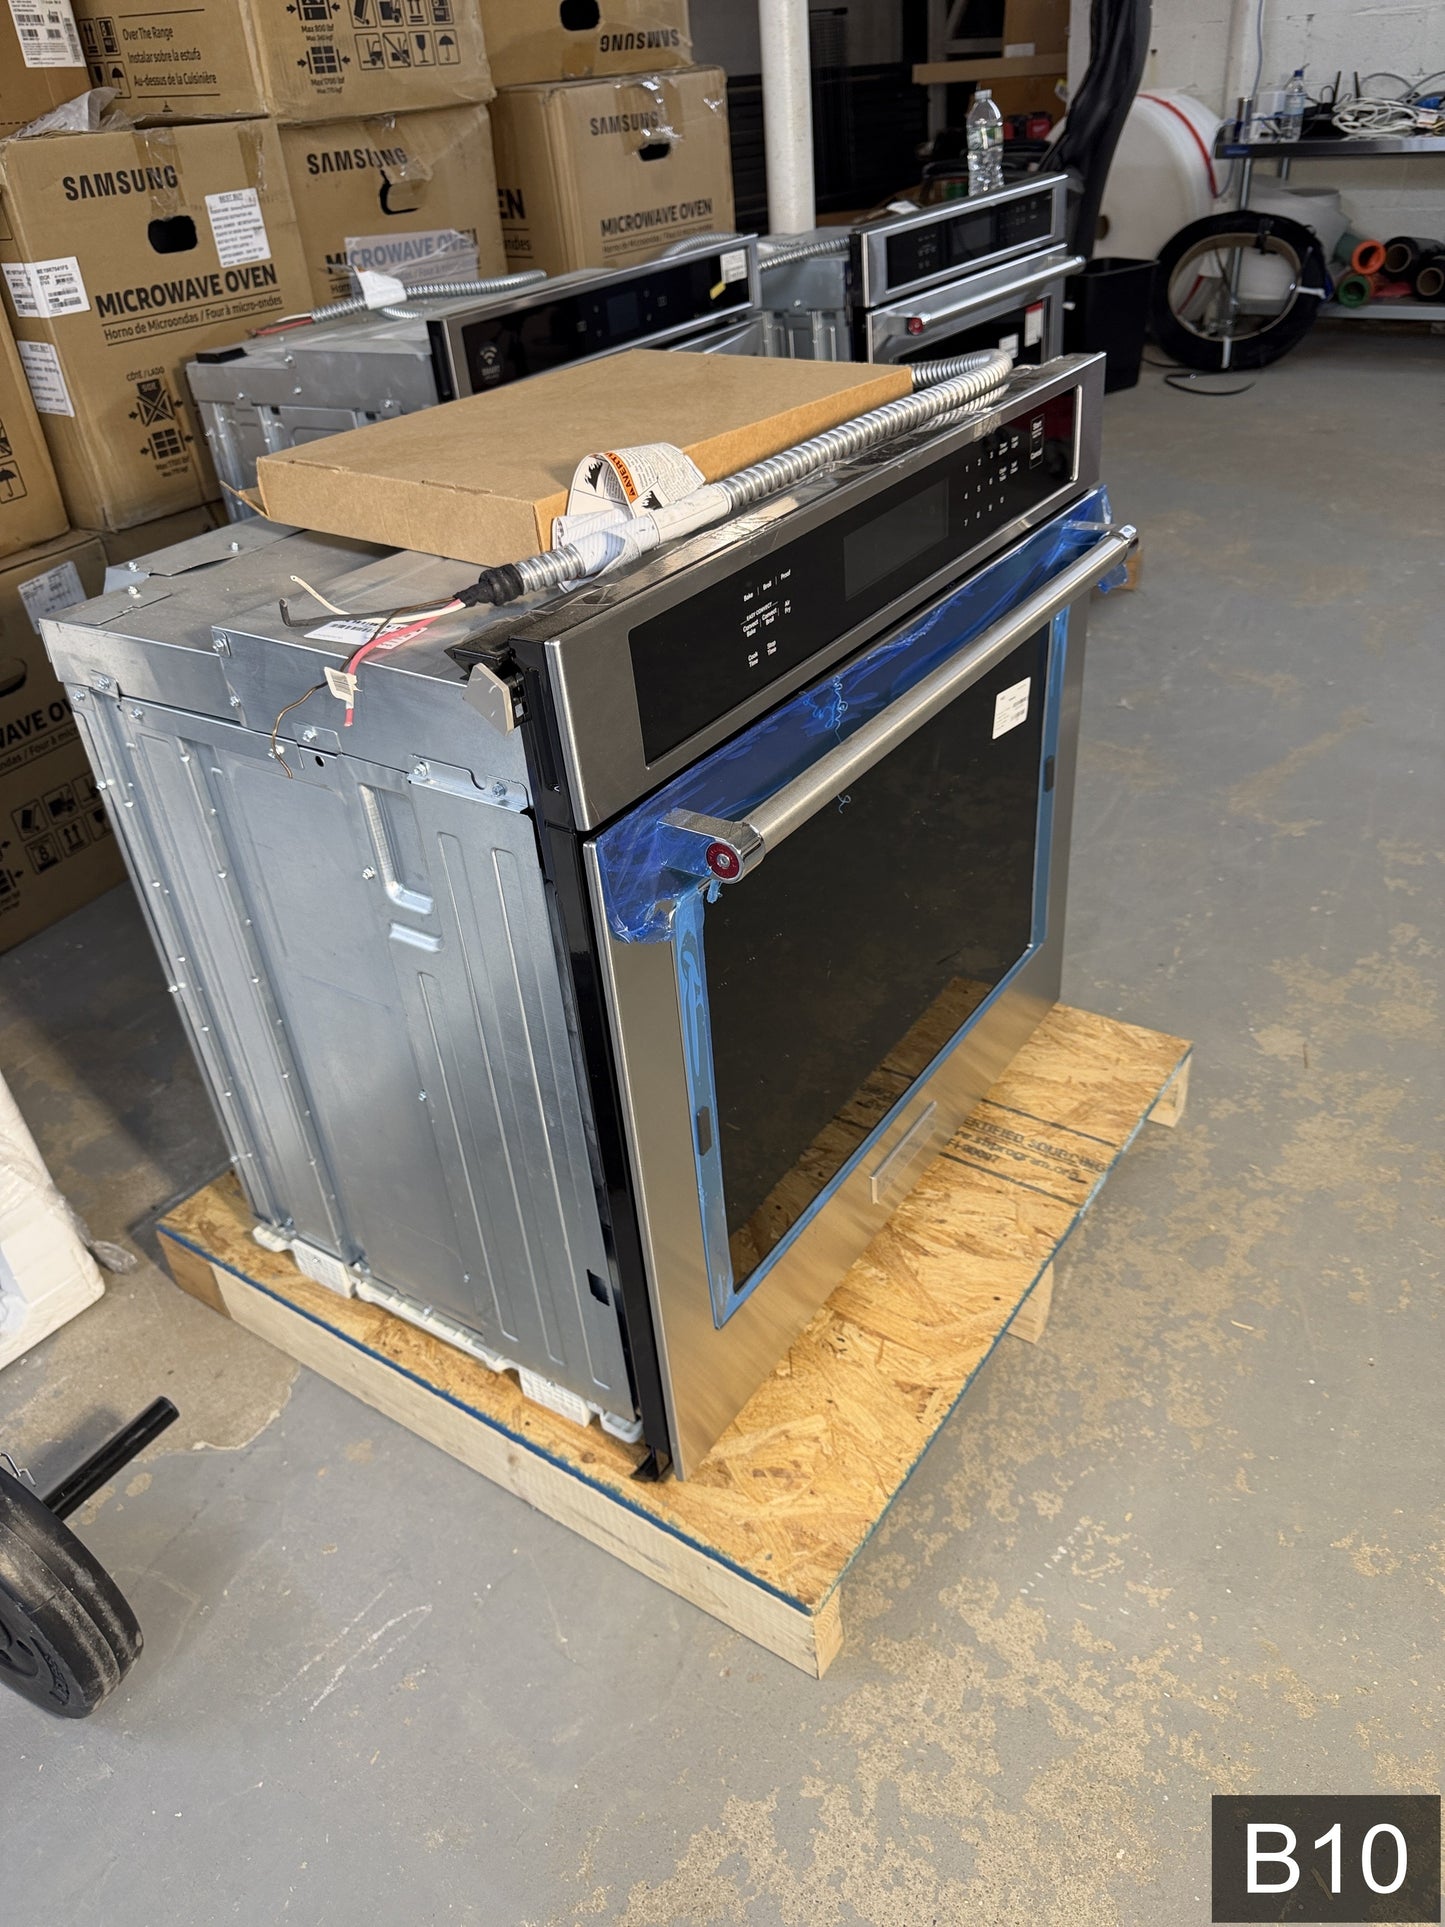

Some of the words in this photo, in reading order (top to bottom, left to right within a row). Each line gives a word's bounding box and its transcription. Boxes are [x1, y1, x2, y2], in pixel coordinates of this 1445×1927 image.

[122, 28, 139, 41] Over
[139, 27, 151, 39] The
[151, 26, 173, 42] Range
[600, 28, 680, 52] SAMSUNG
[127, 51, 154, 64] Instalar
[154, 50, 171, 62] sobre
[172, 49, 180, 61] la
[180, 48, 201, 61] estufa
[134, 74, 167, 87] Au-dessus
[167, 74, 176, 85] de
[177, 73, 183, 84] la
[184, 71, 217, 85] Cuisinière
[590, 111, 659, 136] SAMSUNG
[306, 147, 408, 175] SAMSUNG
[62, 165, 178, 201] SAMSUNG
[601, 205, 677, 236] MICROWAVE
[680, 198, 713, 221] OVEN
[325, 237, 434, 275] MICROWAVE
[95, 273, 223, 318] MICROWAVE
[225, 263, 278, 293] OVEN
[104, 326, 134, 341] Horno
[135, 322, 147, 334] de
[147, 313, 199, 332] Microondas
[206, 307, 225, 319] Four
[225, 304, 231, 316] à
[232, 296, 283, 314] micro-ondes
[744, 593, 753, 601] Bake
[763, 581, 772, 590] Broil
[781, 569, 791, 580] Proof
[743, 619, 759, 632] Convect
[762, 608, 777, 620] Convect
[766, 616, 774, 625] Broil
[746, 628, 756, 637] Bake
